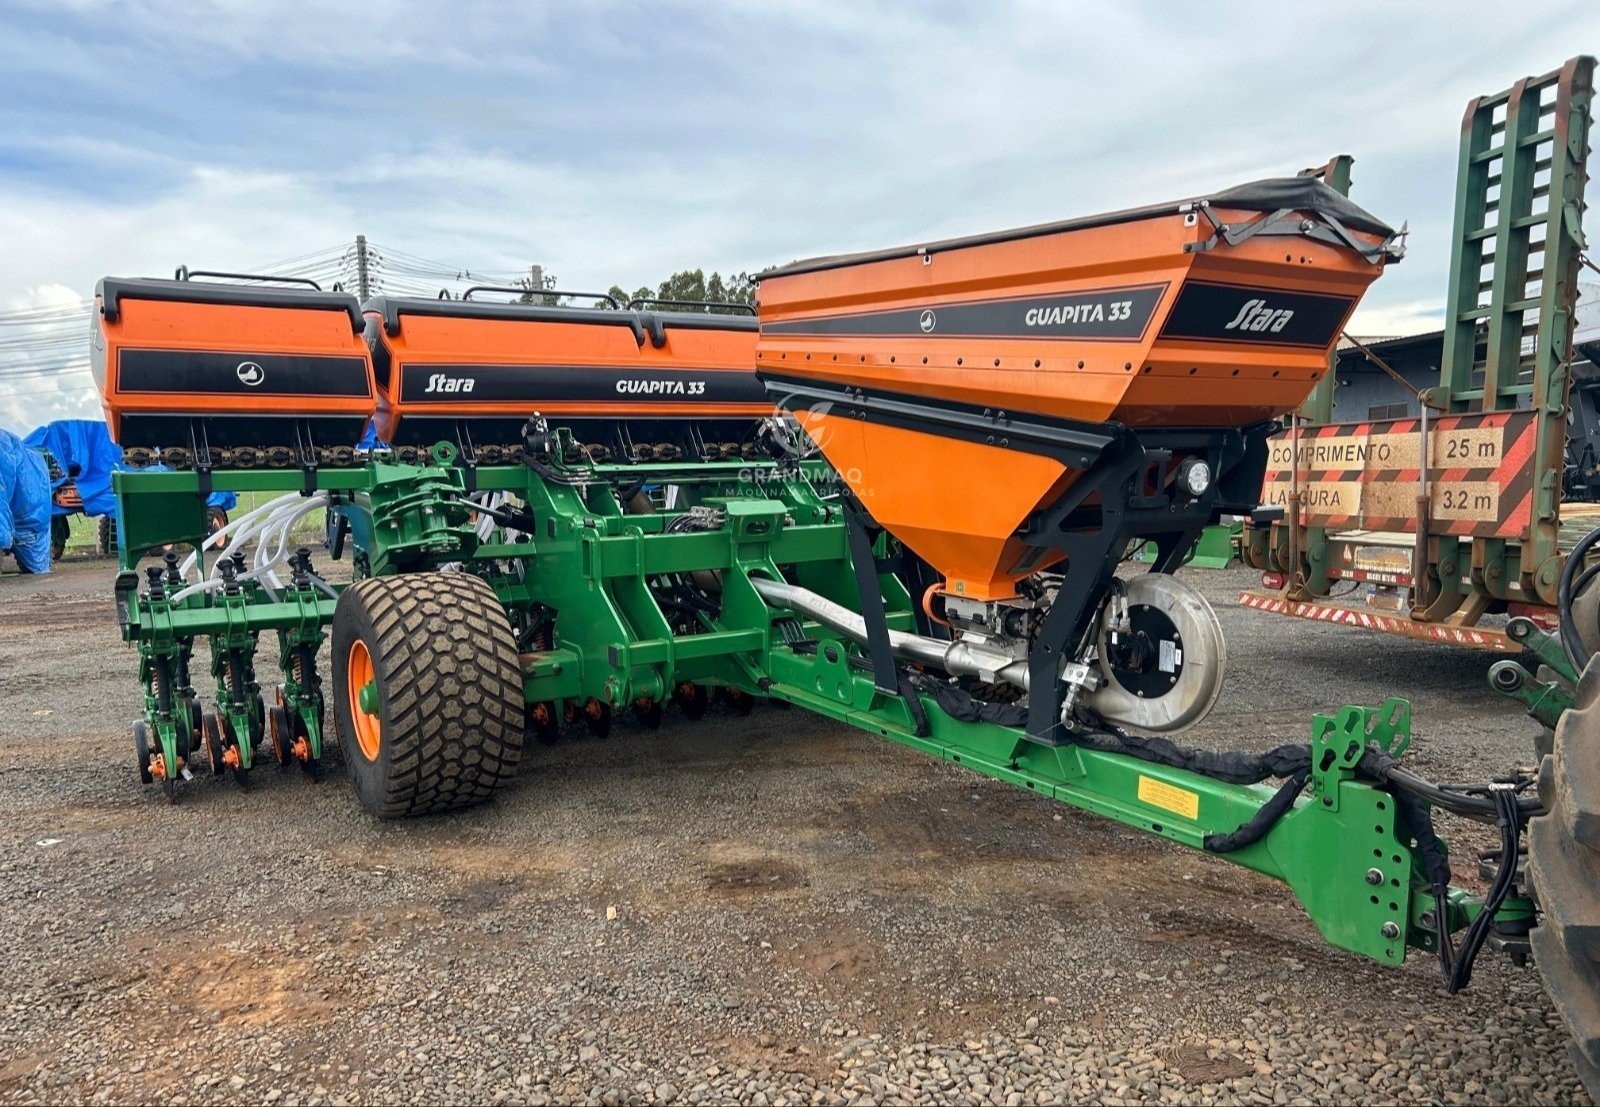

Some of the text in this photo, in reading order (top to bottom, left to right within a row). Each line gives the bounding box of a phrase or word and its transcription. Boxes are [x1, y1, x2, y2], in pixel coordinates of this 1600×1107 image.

[1025, 301, 1132, 326] GUAPITA 33
[1225, 299, 1294, 332] Stara
[425, 374, 475, 393] Stara
[616, 380, 706, 395] GUAPITA 33
[1272, 439, 1495, 463] COMPRIMENTO 25 m
[1269, 489, 1491, 509] LAGURA 3.2 m
